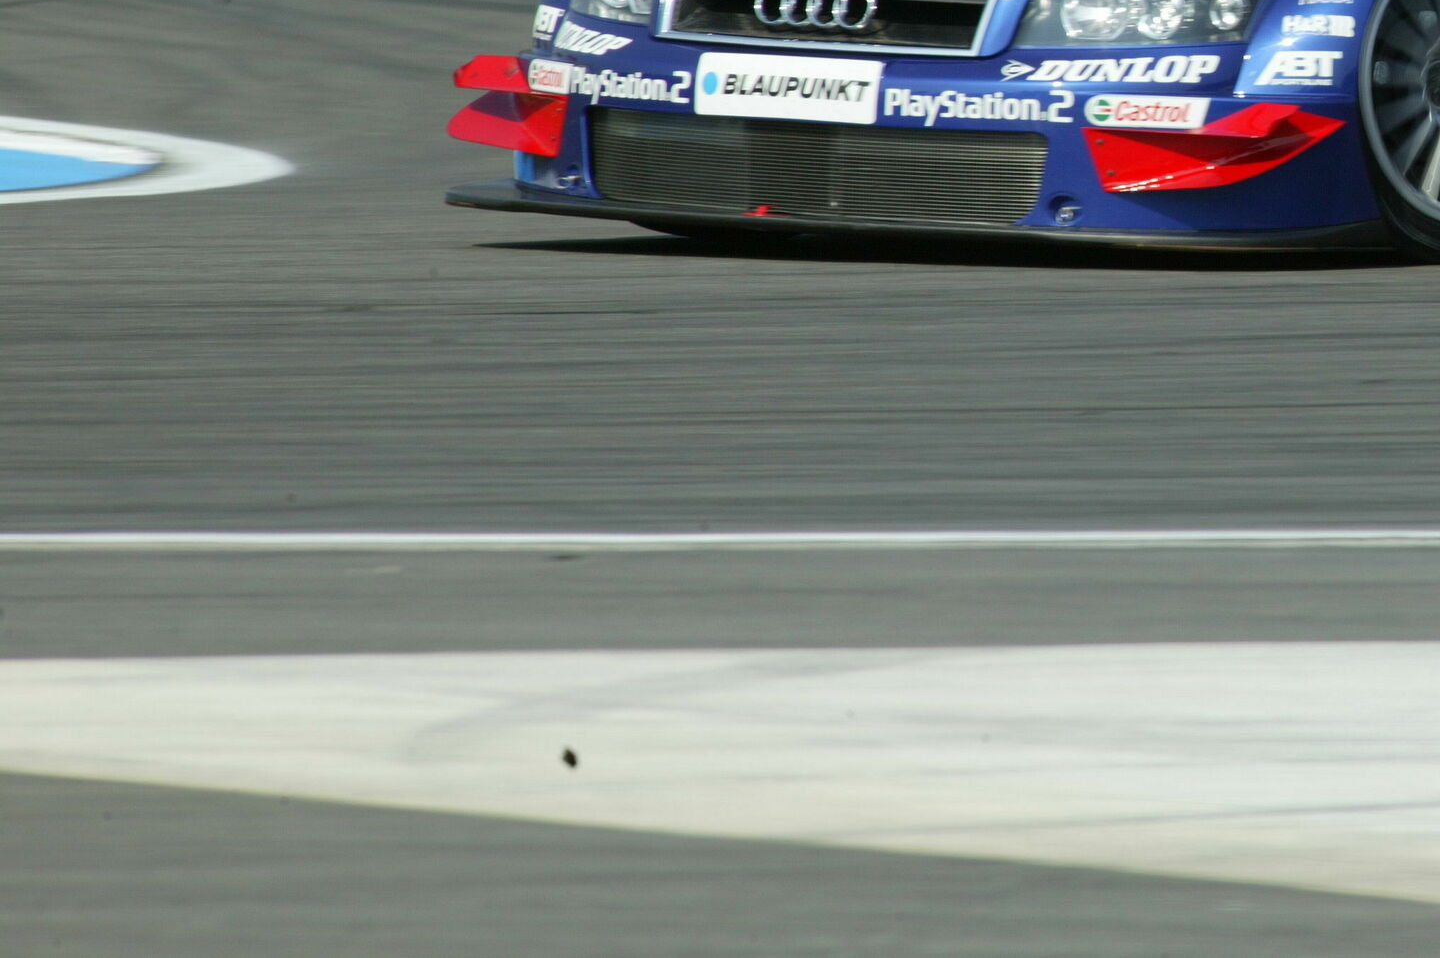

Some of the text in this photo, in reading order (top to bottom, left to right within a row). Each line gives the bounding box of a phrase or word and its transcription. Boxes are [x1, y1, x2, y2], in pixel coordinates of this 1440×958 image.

[1026, 54, 1220, 84] DUNLOP
[1253, 50, 1343, 86] ABT
[723, 73, 872, 102] BLAUPUNKT
[1115, 99, 1193, 124] Castrol
